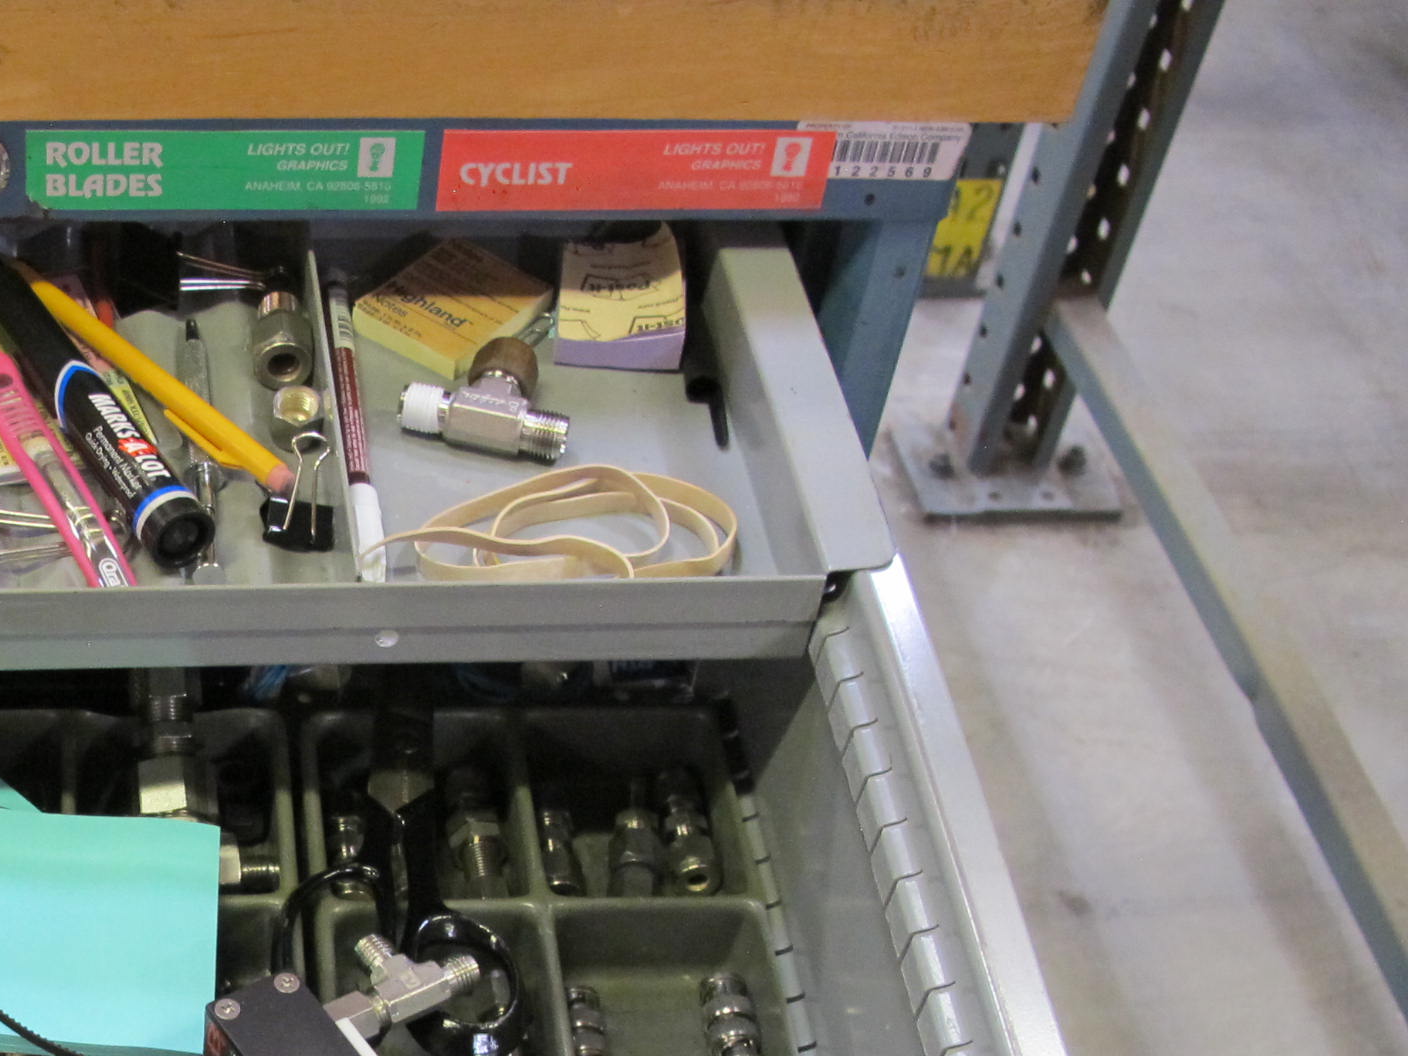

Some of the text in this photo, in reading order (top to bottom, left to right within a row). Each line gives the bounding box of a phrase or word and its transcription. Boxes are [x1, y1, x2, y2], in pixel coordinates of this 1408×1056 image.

[920, 133, 962, 142] Company
[45, 142, 164, 168] ROLLER
[248, 143, 351, 156] LIGHTS OUT!
[664, 143, 767, 155] LIGHTS OUT!
[277, 159, 349, 171] GRAPHICS
[691, 159, 762, 171] GRAPHICS
[460, 162, 574, 187] CYCLIST
[45, 173, 164, 200] BLADES
[306, 181, 324, 191] CA
[88, 393, 173, 479] MARKS-A-LOT
[92, 425, 126, 466] Permanent
[119, 461, 143, 490] Marker
